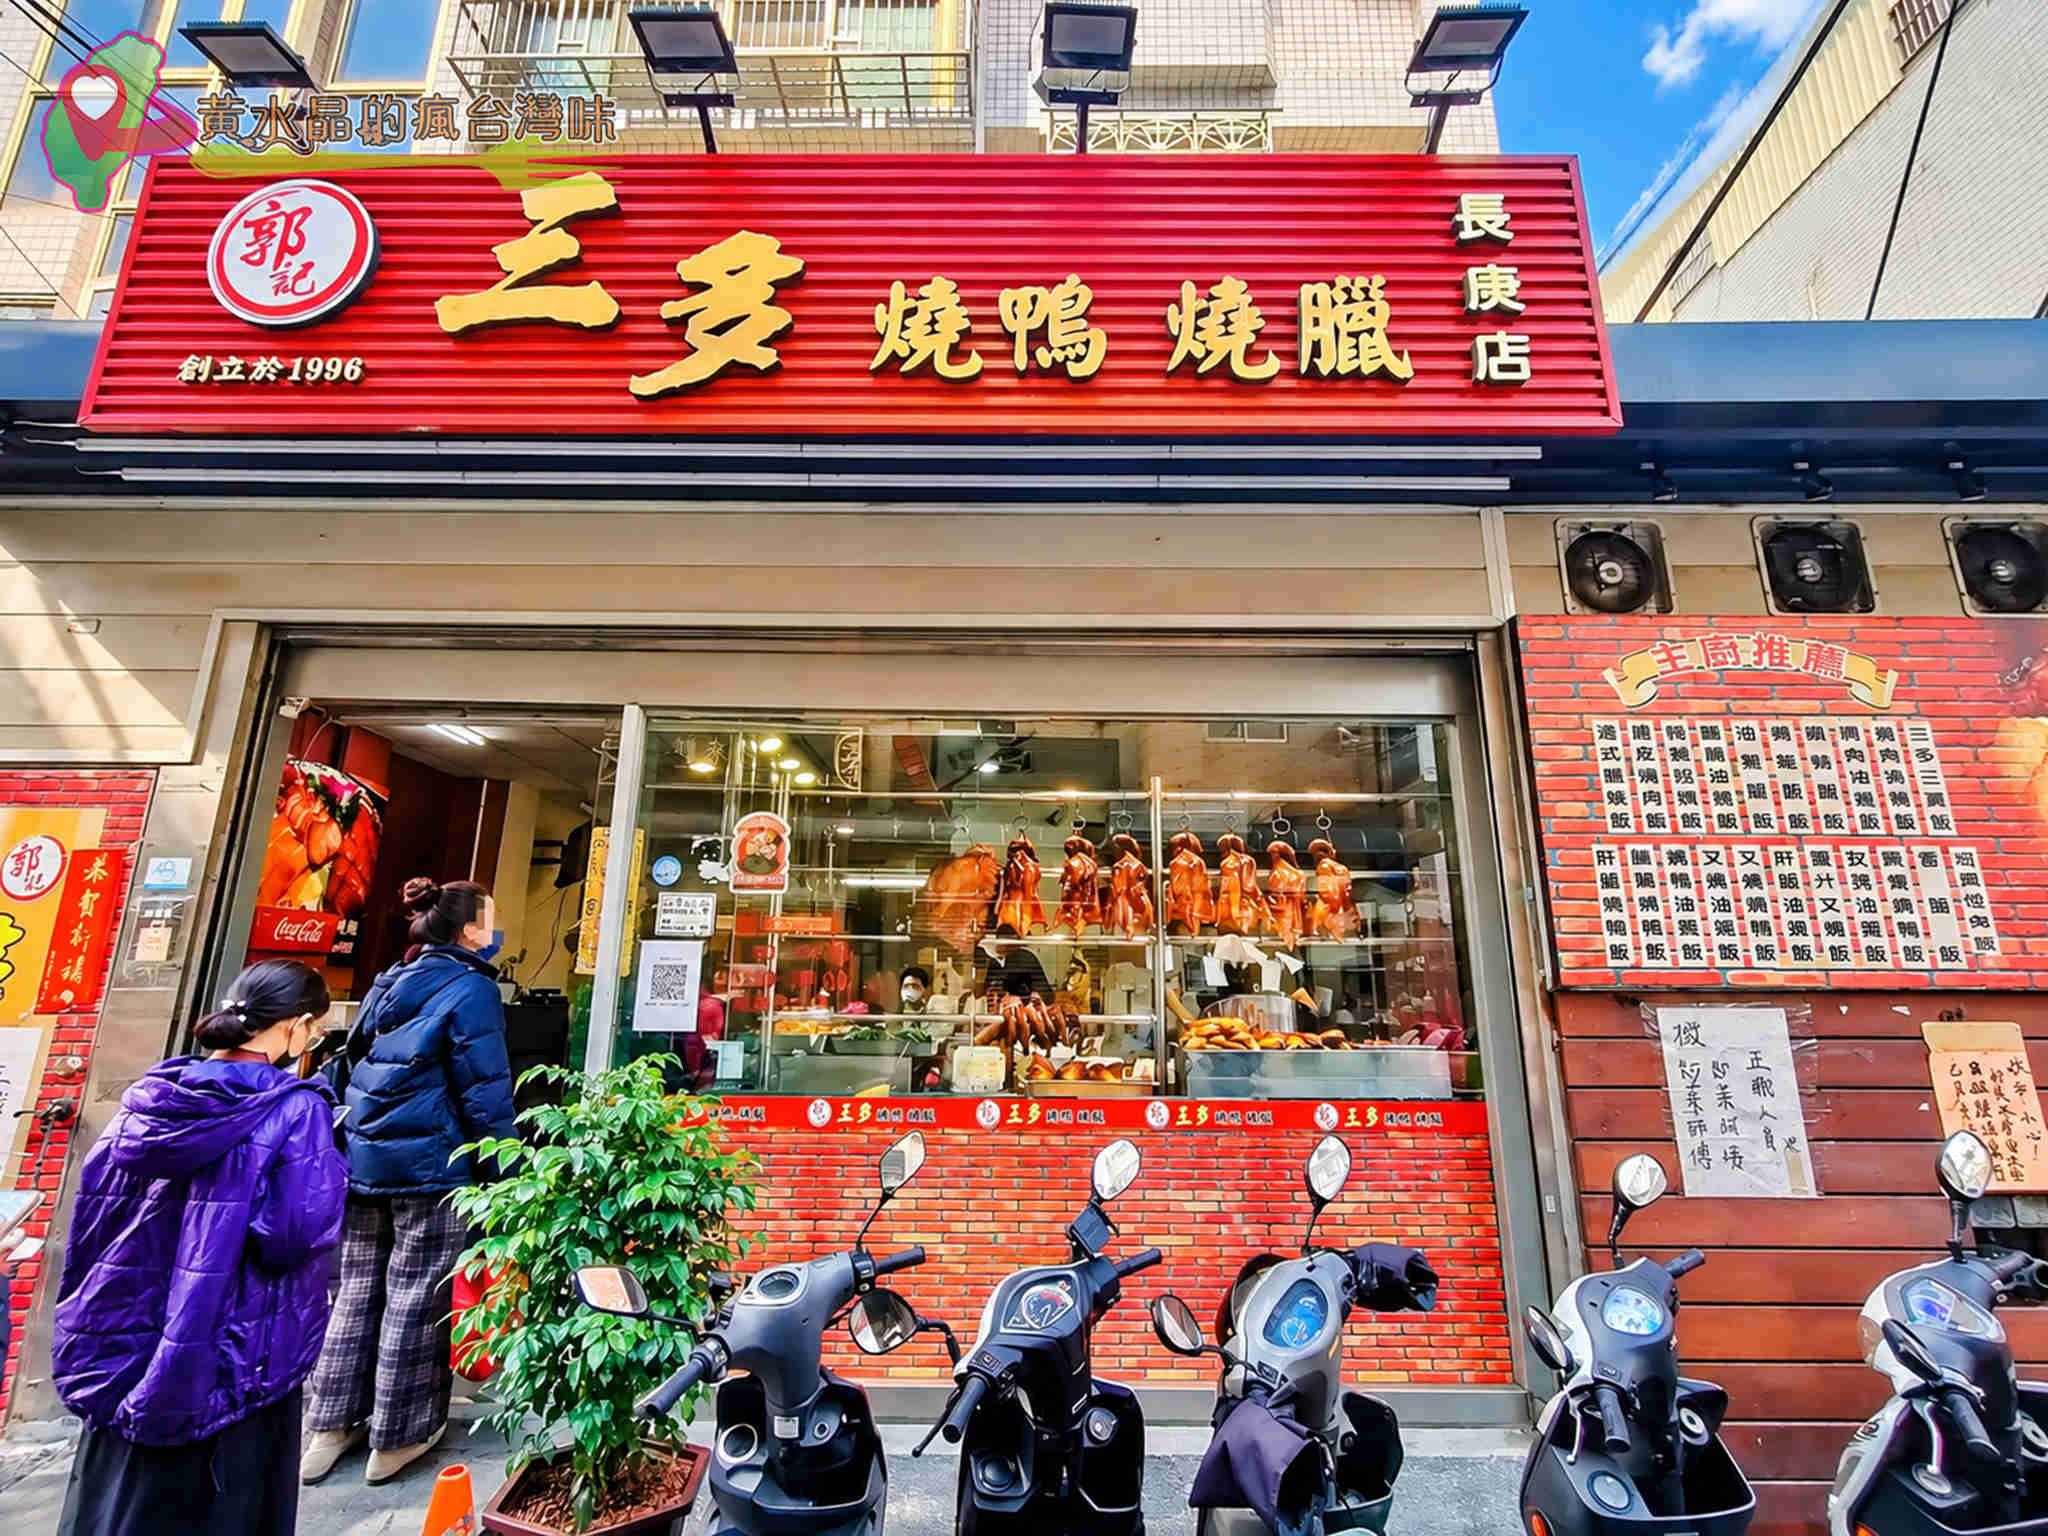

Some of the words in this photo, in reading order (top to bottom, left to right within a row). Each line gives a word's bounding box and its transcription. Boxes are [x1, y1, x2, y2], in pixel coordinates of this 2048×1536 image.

[240, 200, 315, 296] 郭記
[434, 172, 804, 397] 三多
[870, 274, 1107, 380] 燒鴨
[1167, 275, 1414, 381] 燒臘
[1455, 193, 1530, 382] 長庚店
[177, 354, 364, 383] 創立於1996
[1648, 633, 1848, 681] 主廚推薦
